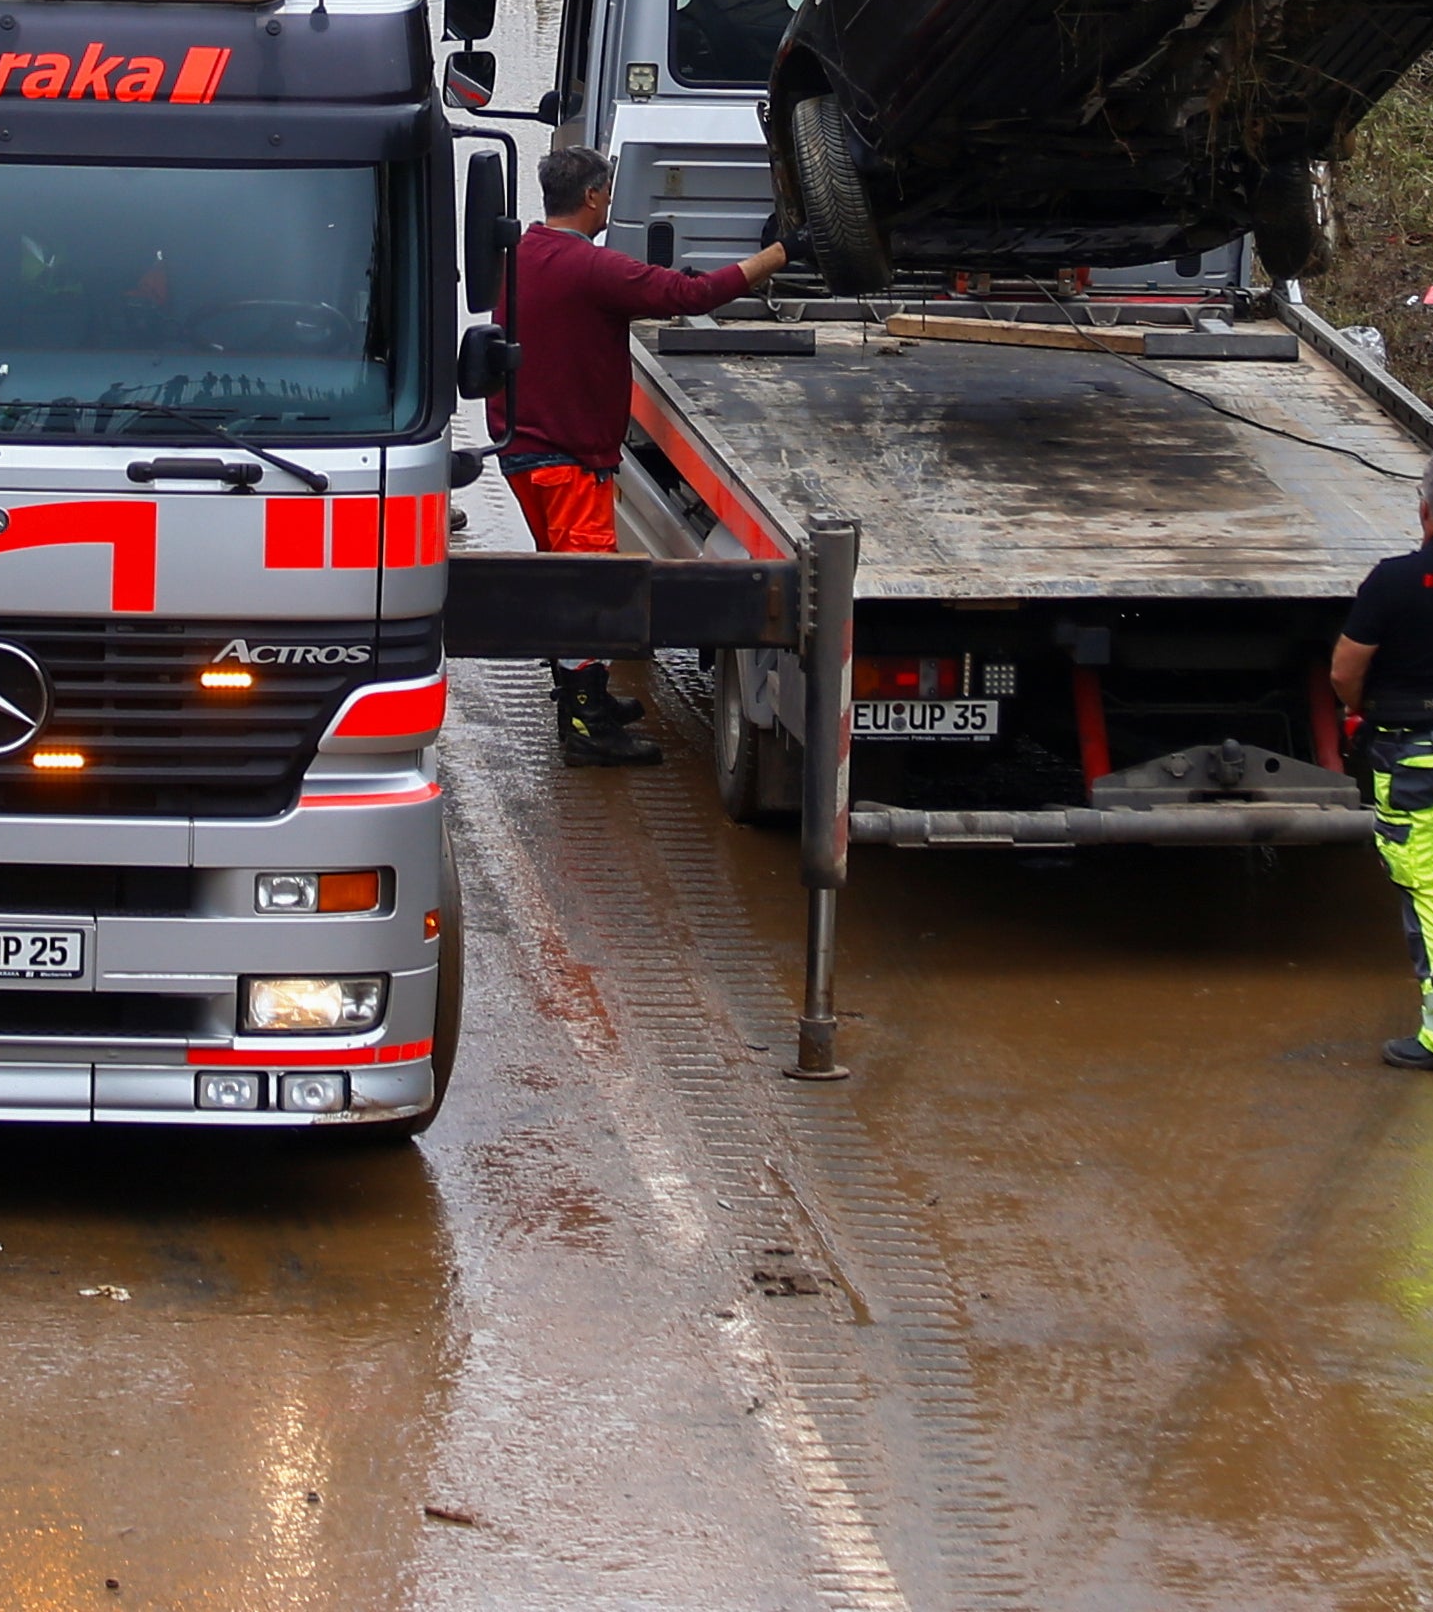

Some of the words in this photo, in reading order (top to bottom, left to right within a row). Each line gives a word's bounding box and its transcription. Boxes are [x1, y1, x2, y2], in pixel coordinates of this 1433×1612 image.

[854, 704, 889, 730] EU
[909, 704, 946, 730] UP
[953, 704, 987, 731] 35
[29, 936, 68, 966] 25
